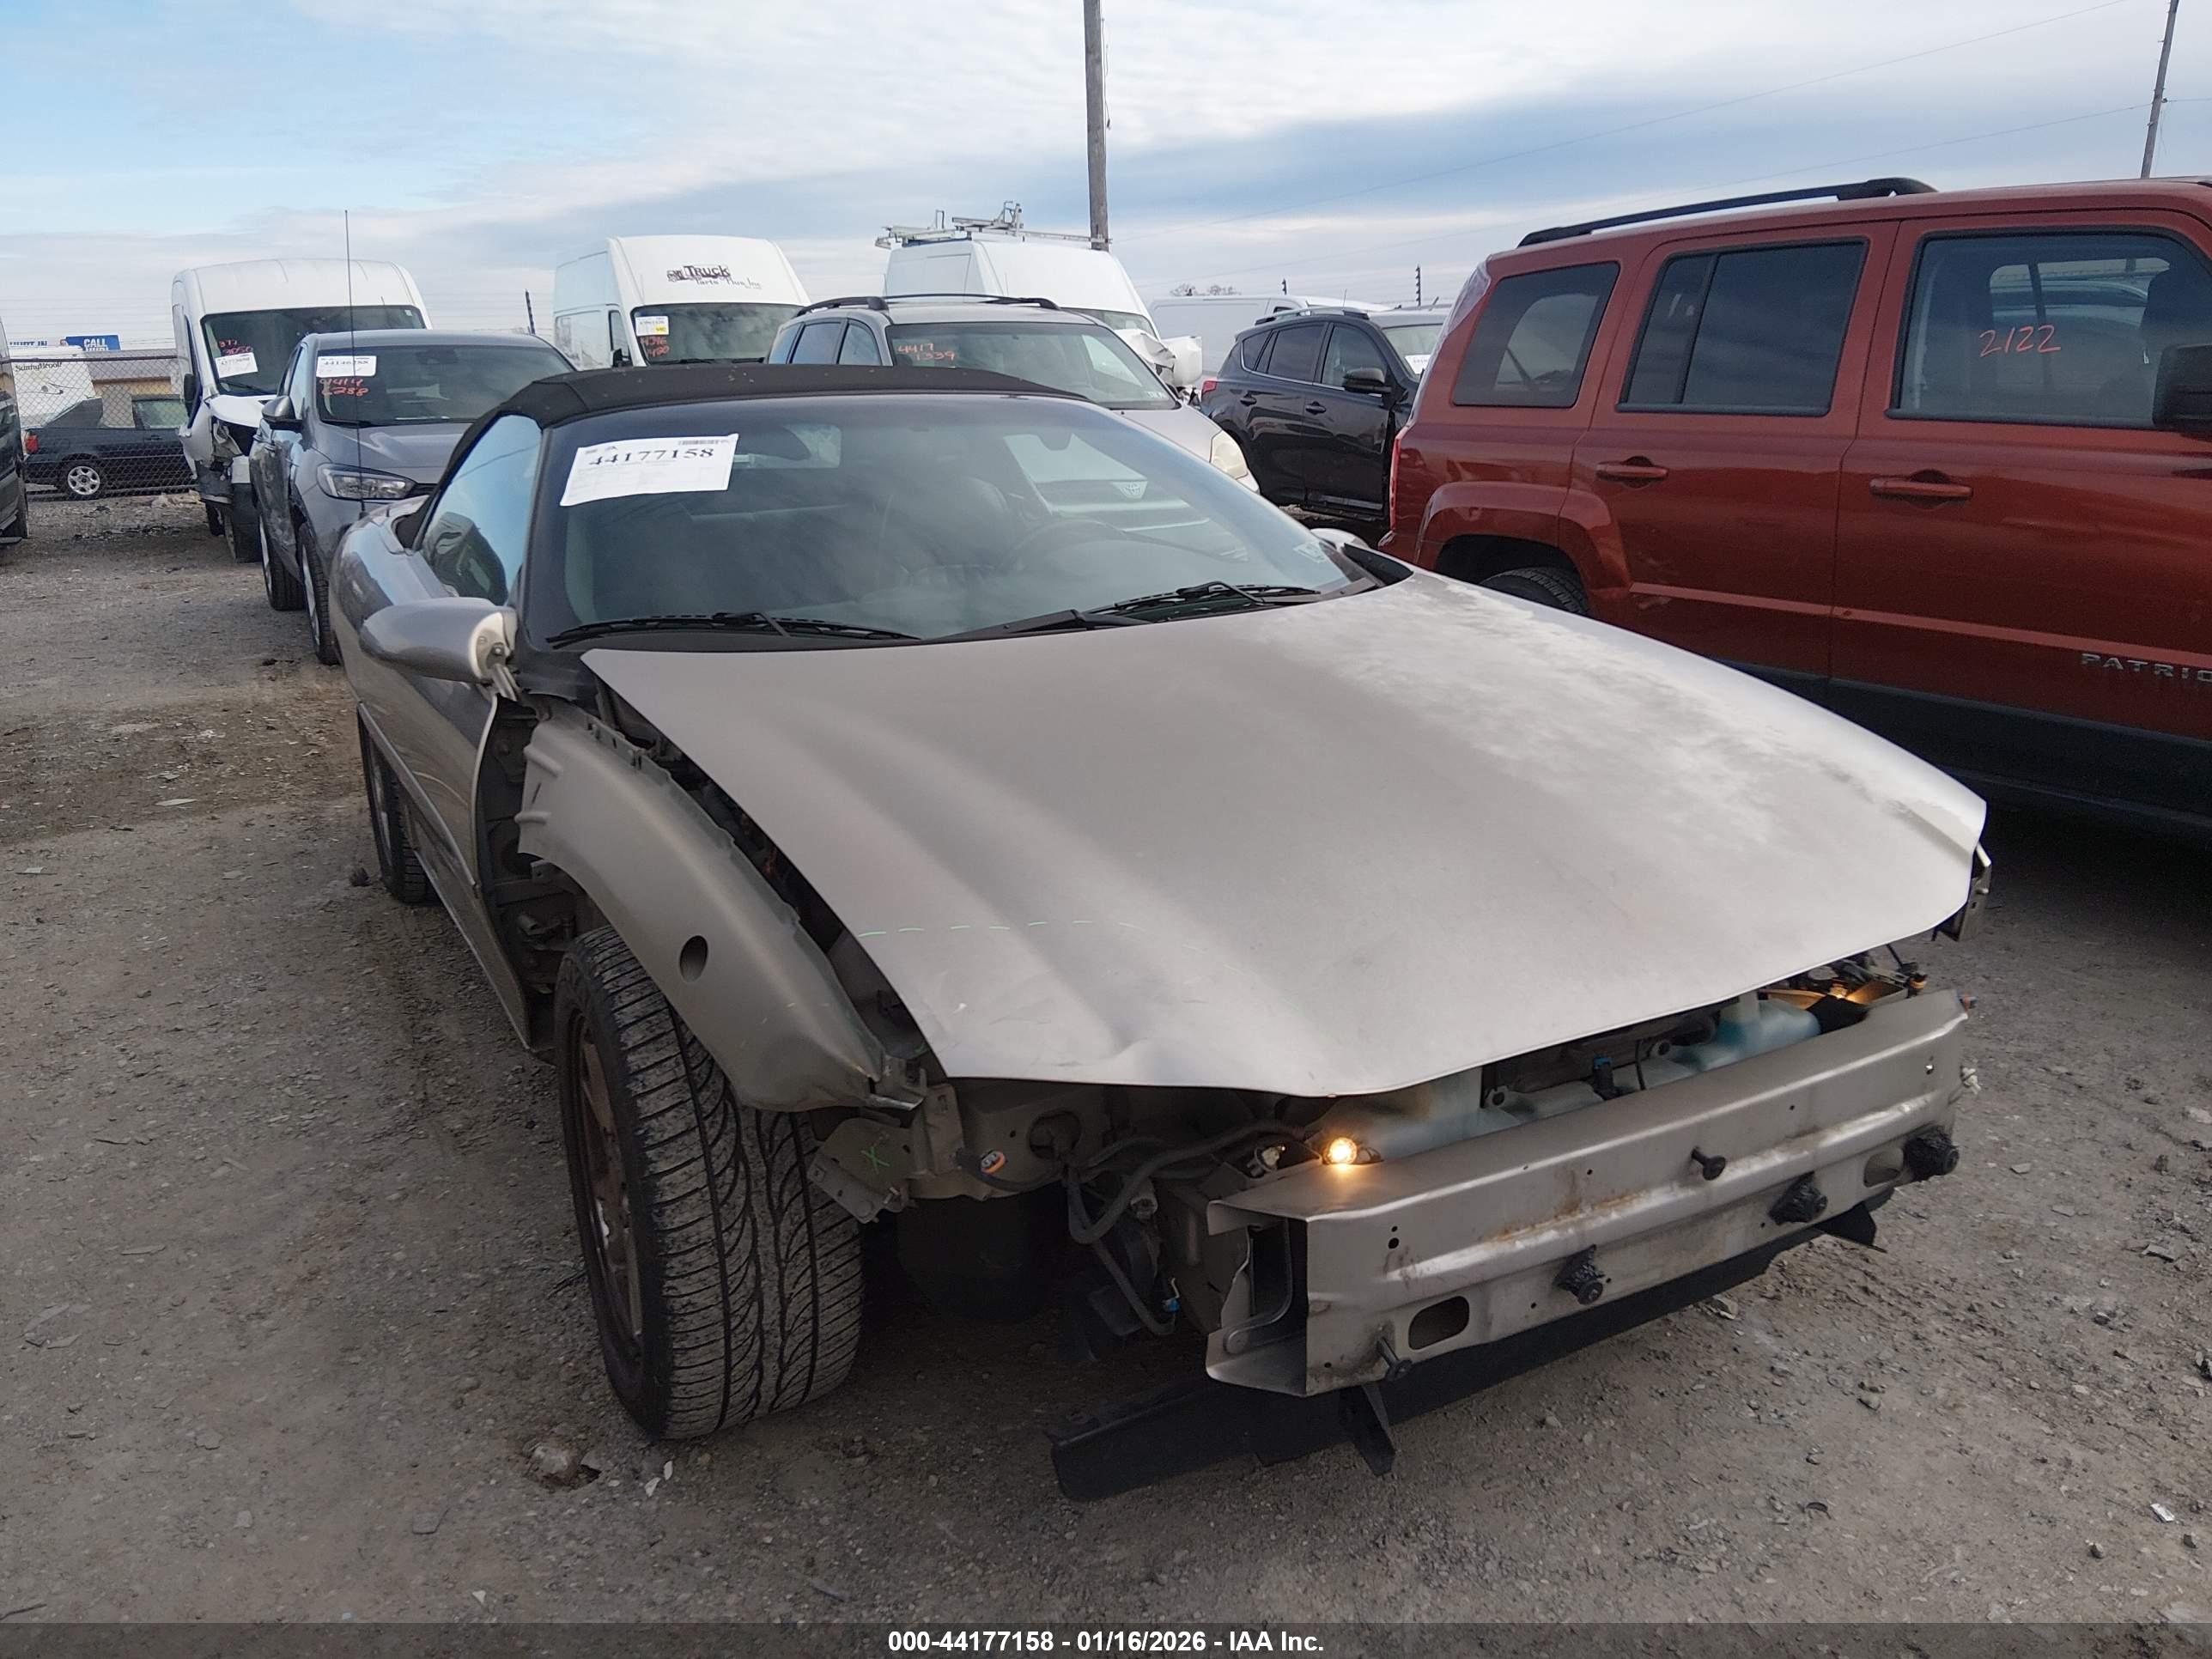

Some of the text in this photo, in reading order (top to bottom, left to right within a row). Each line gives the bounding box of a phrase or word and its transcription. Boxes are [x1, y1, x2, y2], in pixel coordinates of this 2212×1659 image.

[83, 338, 106, 348] CALL
[1978, 325, 2061, 357] 2122
[898, 343, 934, 353] 4417
[588, 448, 714, 465] 44177158
